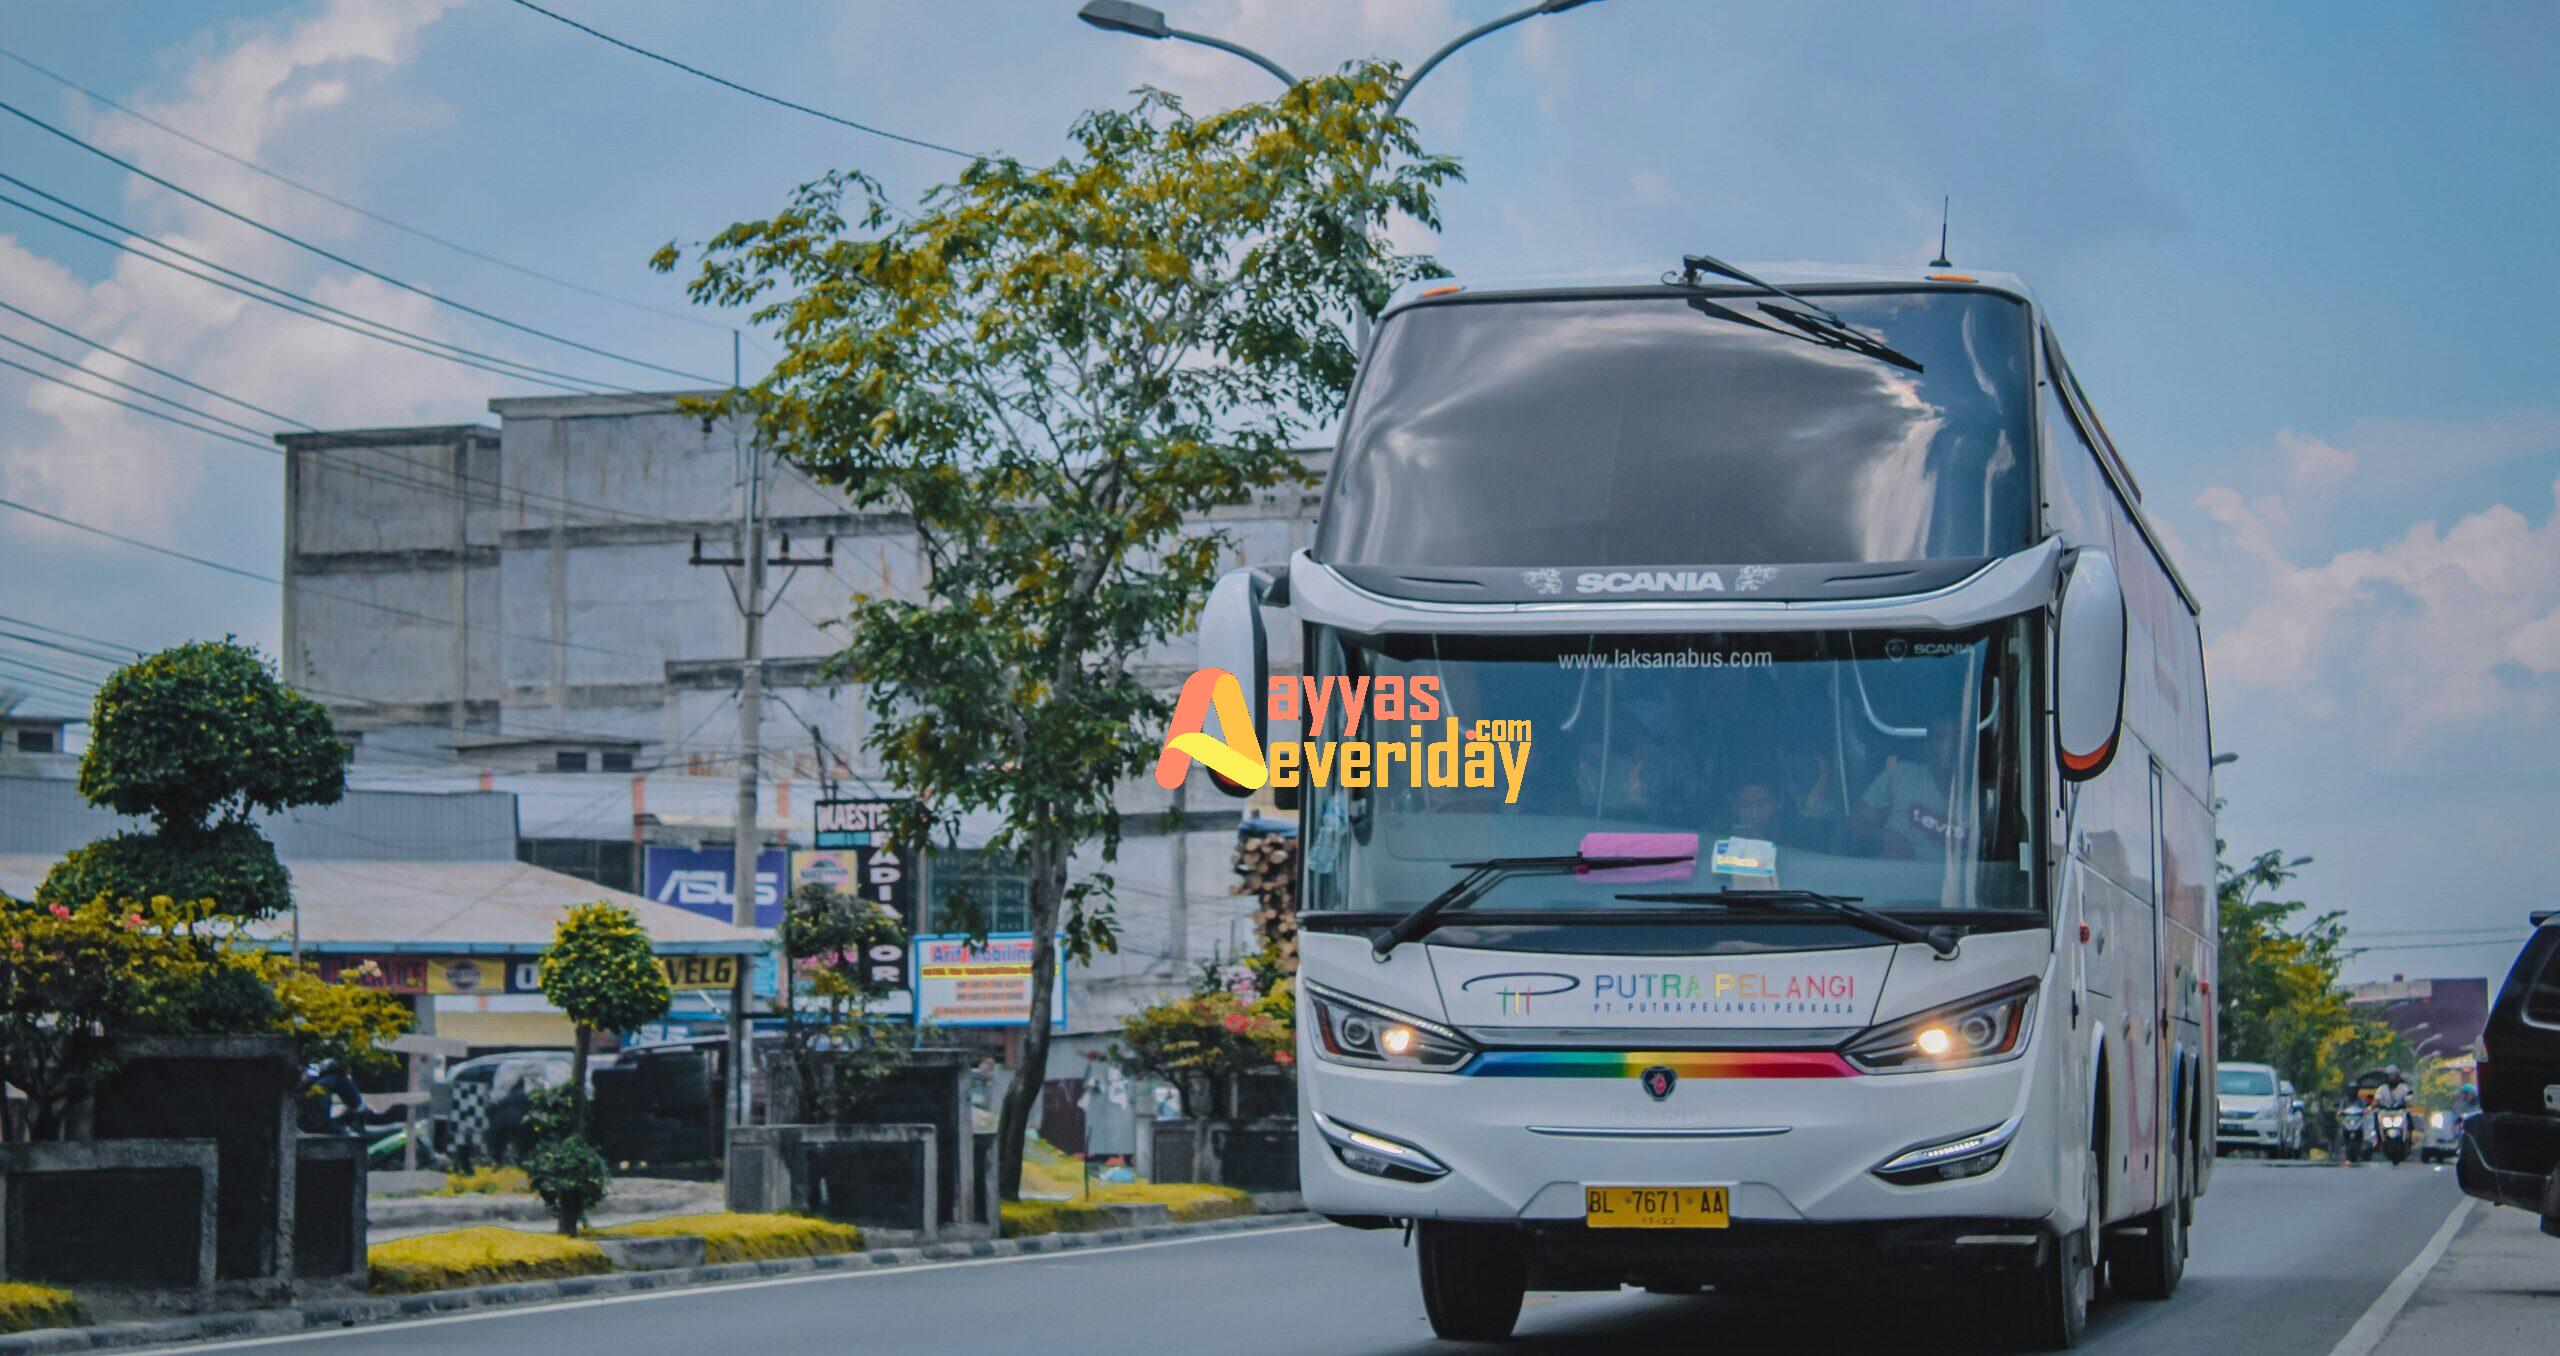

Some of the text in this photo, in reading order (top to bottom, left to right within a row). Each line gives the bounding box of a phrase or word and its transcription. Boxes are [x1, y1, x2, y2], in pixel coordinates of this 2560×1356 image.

[1575, 571, 1725, 593] SCANIA
[1558, 648, 1772, 669] www.laksanabus.com
[1912, 643, 1972, 655] SCANIA
[665, 956, 731, 985] VELG
[1594, 972, 1854, 999] PUTRA PELANGI
[1628, 1002, 1681, 1013] PUTRA
[1690, 1002, 1766, 1013] PELANGI
[1774, 1002, 1853, 1014] PERKASA
[1589, 1190, 1724, 1213] BL 7671 AA
